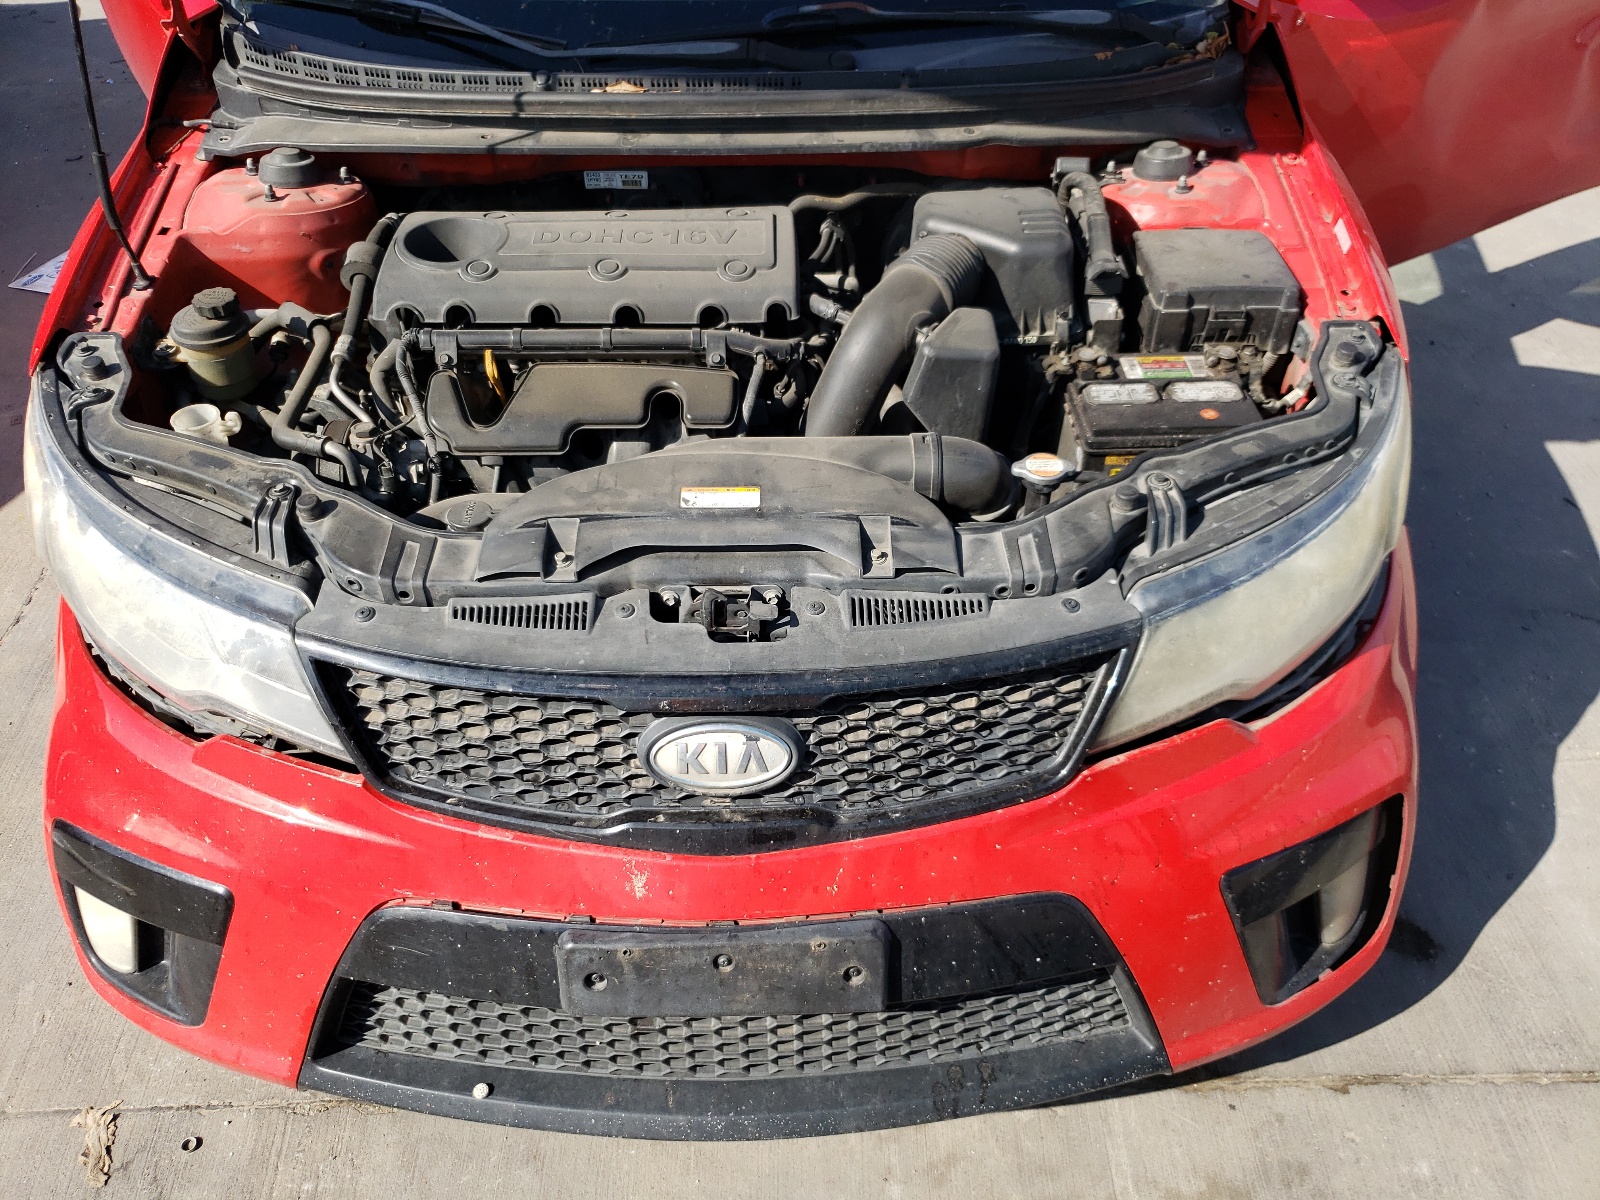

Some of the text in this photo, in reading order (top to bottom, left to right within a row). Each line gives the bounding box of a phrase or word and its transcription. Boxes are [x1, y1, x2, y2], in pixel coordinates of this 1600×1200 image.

[531, 228, 738, 245] DOHC 16V
[674, 740, 770, 775] KIA
